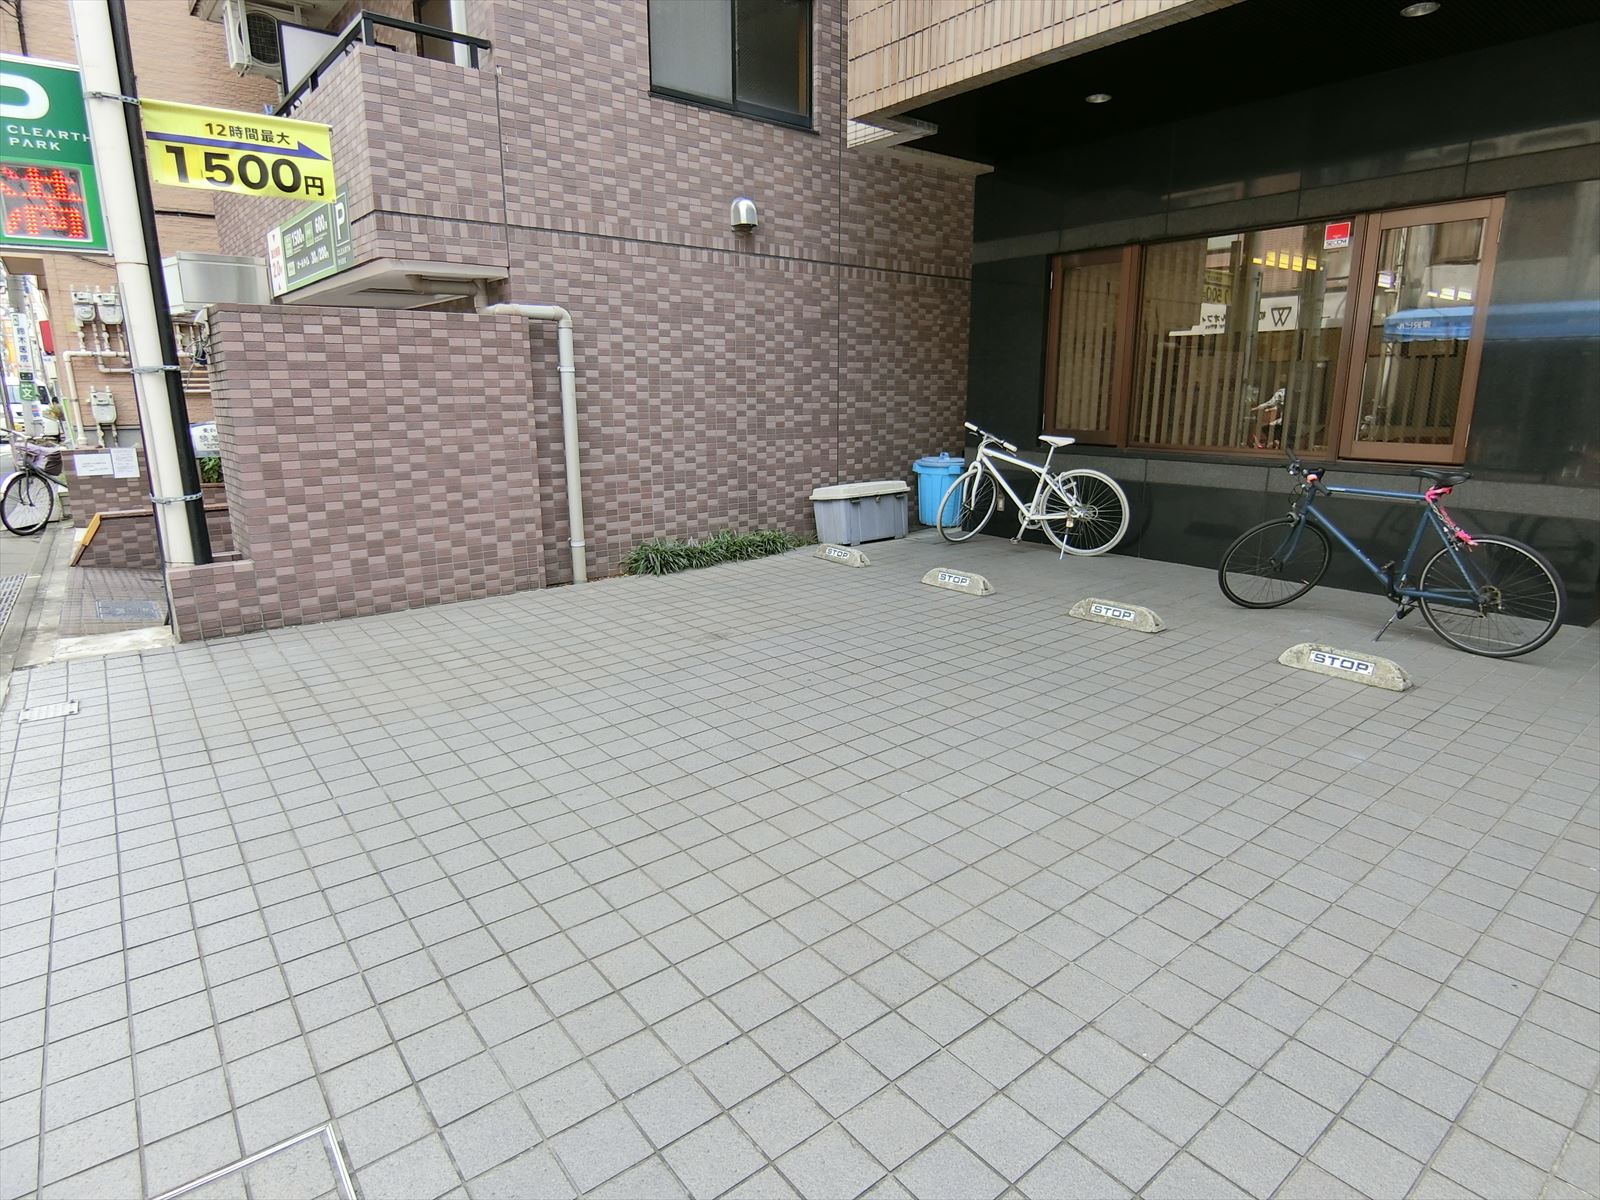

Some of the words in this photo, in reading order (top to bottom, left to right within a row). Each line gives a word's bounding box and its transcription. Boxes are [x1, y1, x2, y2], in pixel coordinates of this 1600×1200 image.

[205, 122, 290, 145] 12時間最大
[9, 137, 61, 151] PARK
[165, 144, 325, 197] 1500円
[335, 202, 345, 240] P
[827, 548, 849, 558] STOP
[939, 573, 970, 584] STOP
[1094, 605, 1132, 619] STOP
[1313, 652, 1369, 671] STOP
